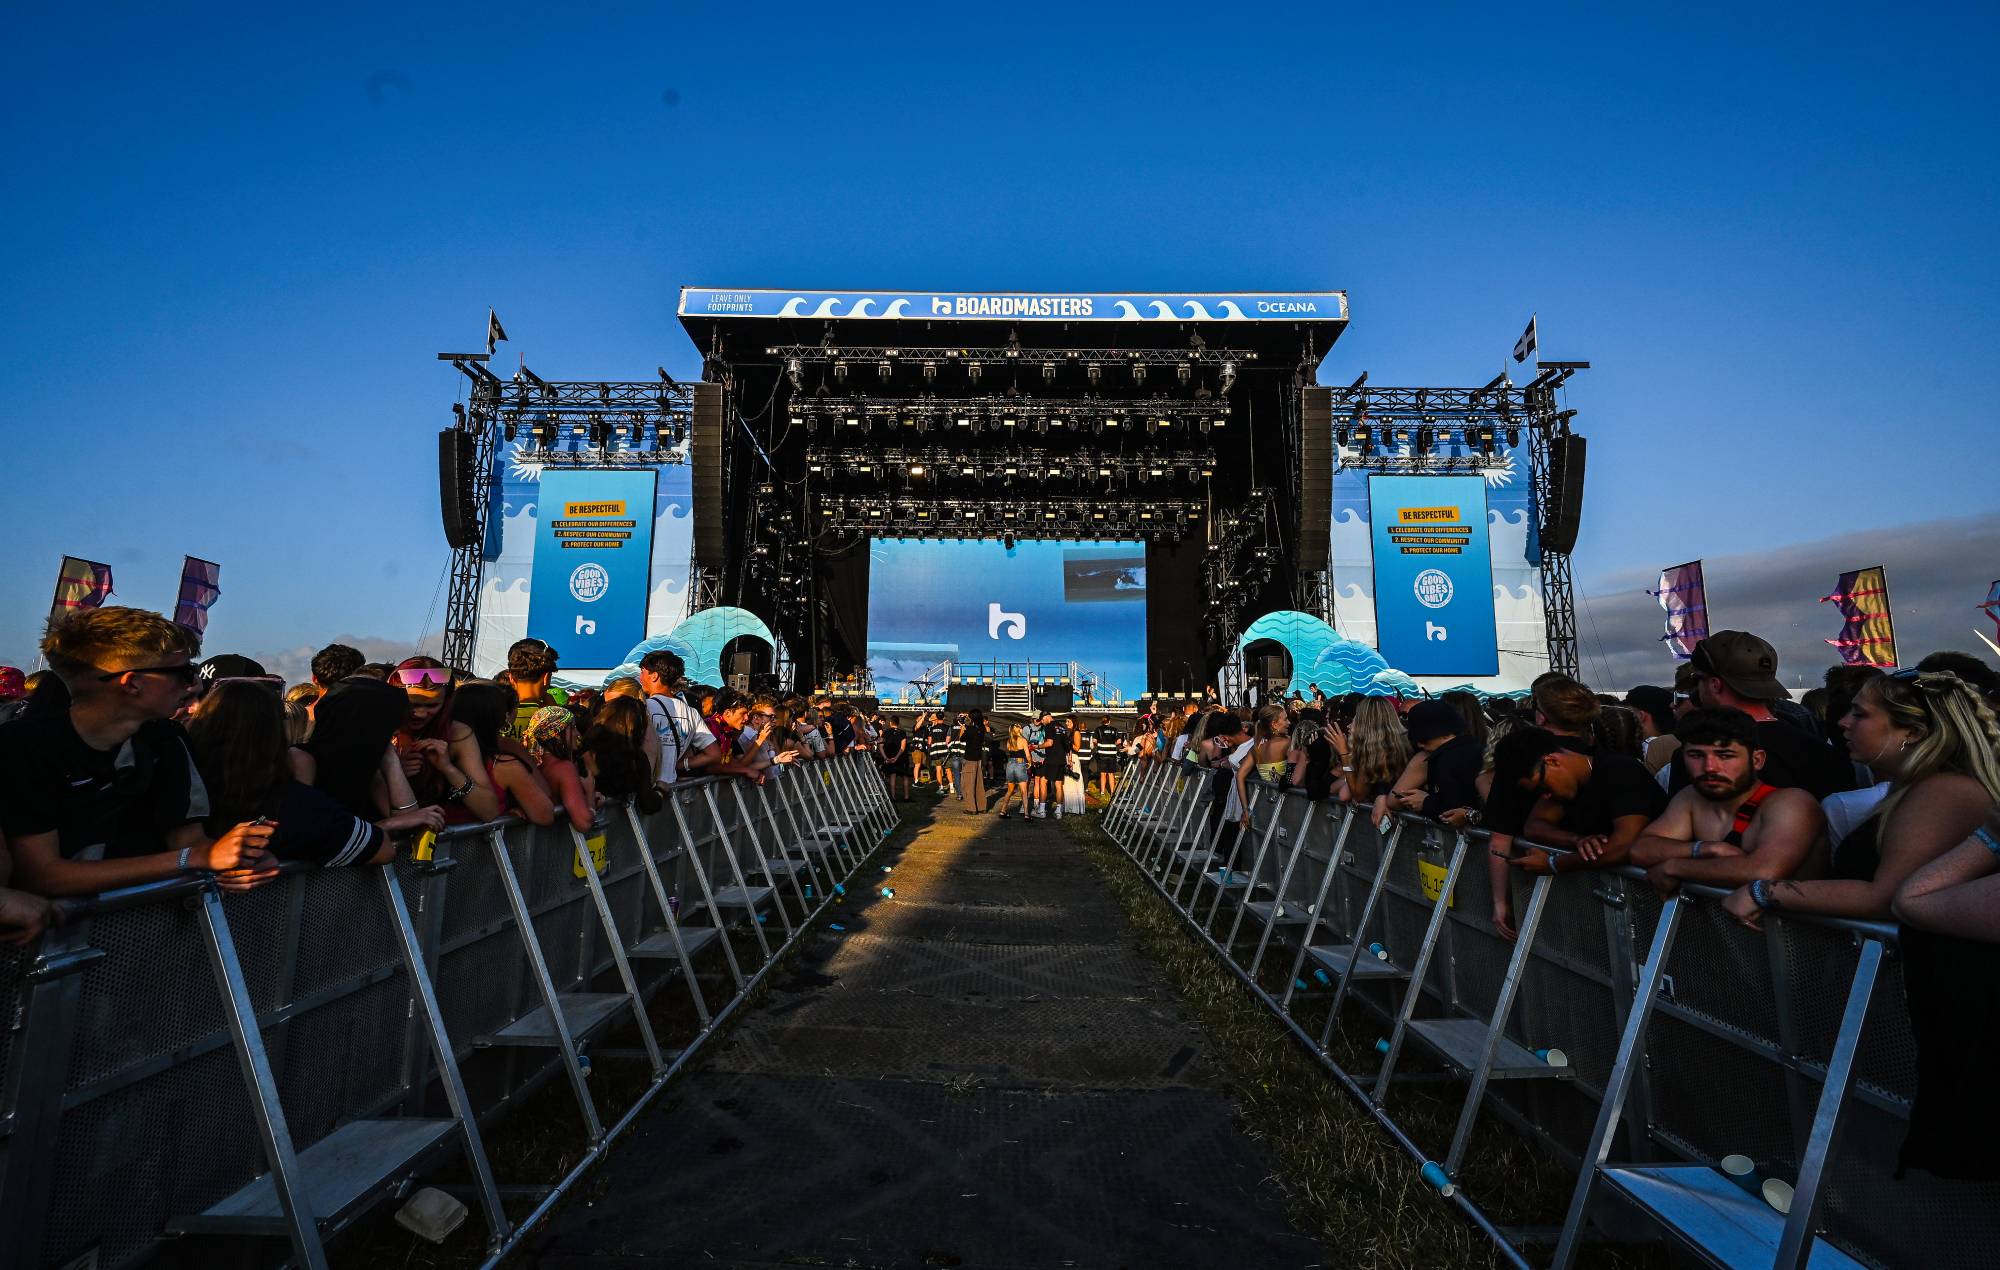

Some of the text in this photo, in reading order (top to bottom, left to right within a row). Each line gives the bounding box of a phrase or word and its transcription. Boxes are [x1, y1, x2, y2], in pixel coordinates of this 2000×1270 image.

[711, 294, 752, 303] LEAVE ONLY
[707, 303, 753, 312] FOOTPRINTS
[955, 297, 1093, 316] BOARDMASTERS
[1256, 301, 1317, 313] OCEANA
[569, 504, 621, 514] BE RESPECTFUL
[1403, 510, 1454, 520] BE RESPECTFUL
[579, 569, 600, 579] GOOD
[575, 578, 603, 588] VIBES
[1422, 575, 1444, 585] GOOD
[579, 587, 599, 596] ONLY
[1420, 584, 1448, 594] VIBES
[1424, 593, 1444, 603] ONLY
[199, 664, 216, 680] NY
